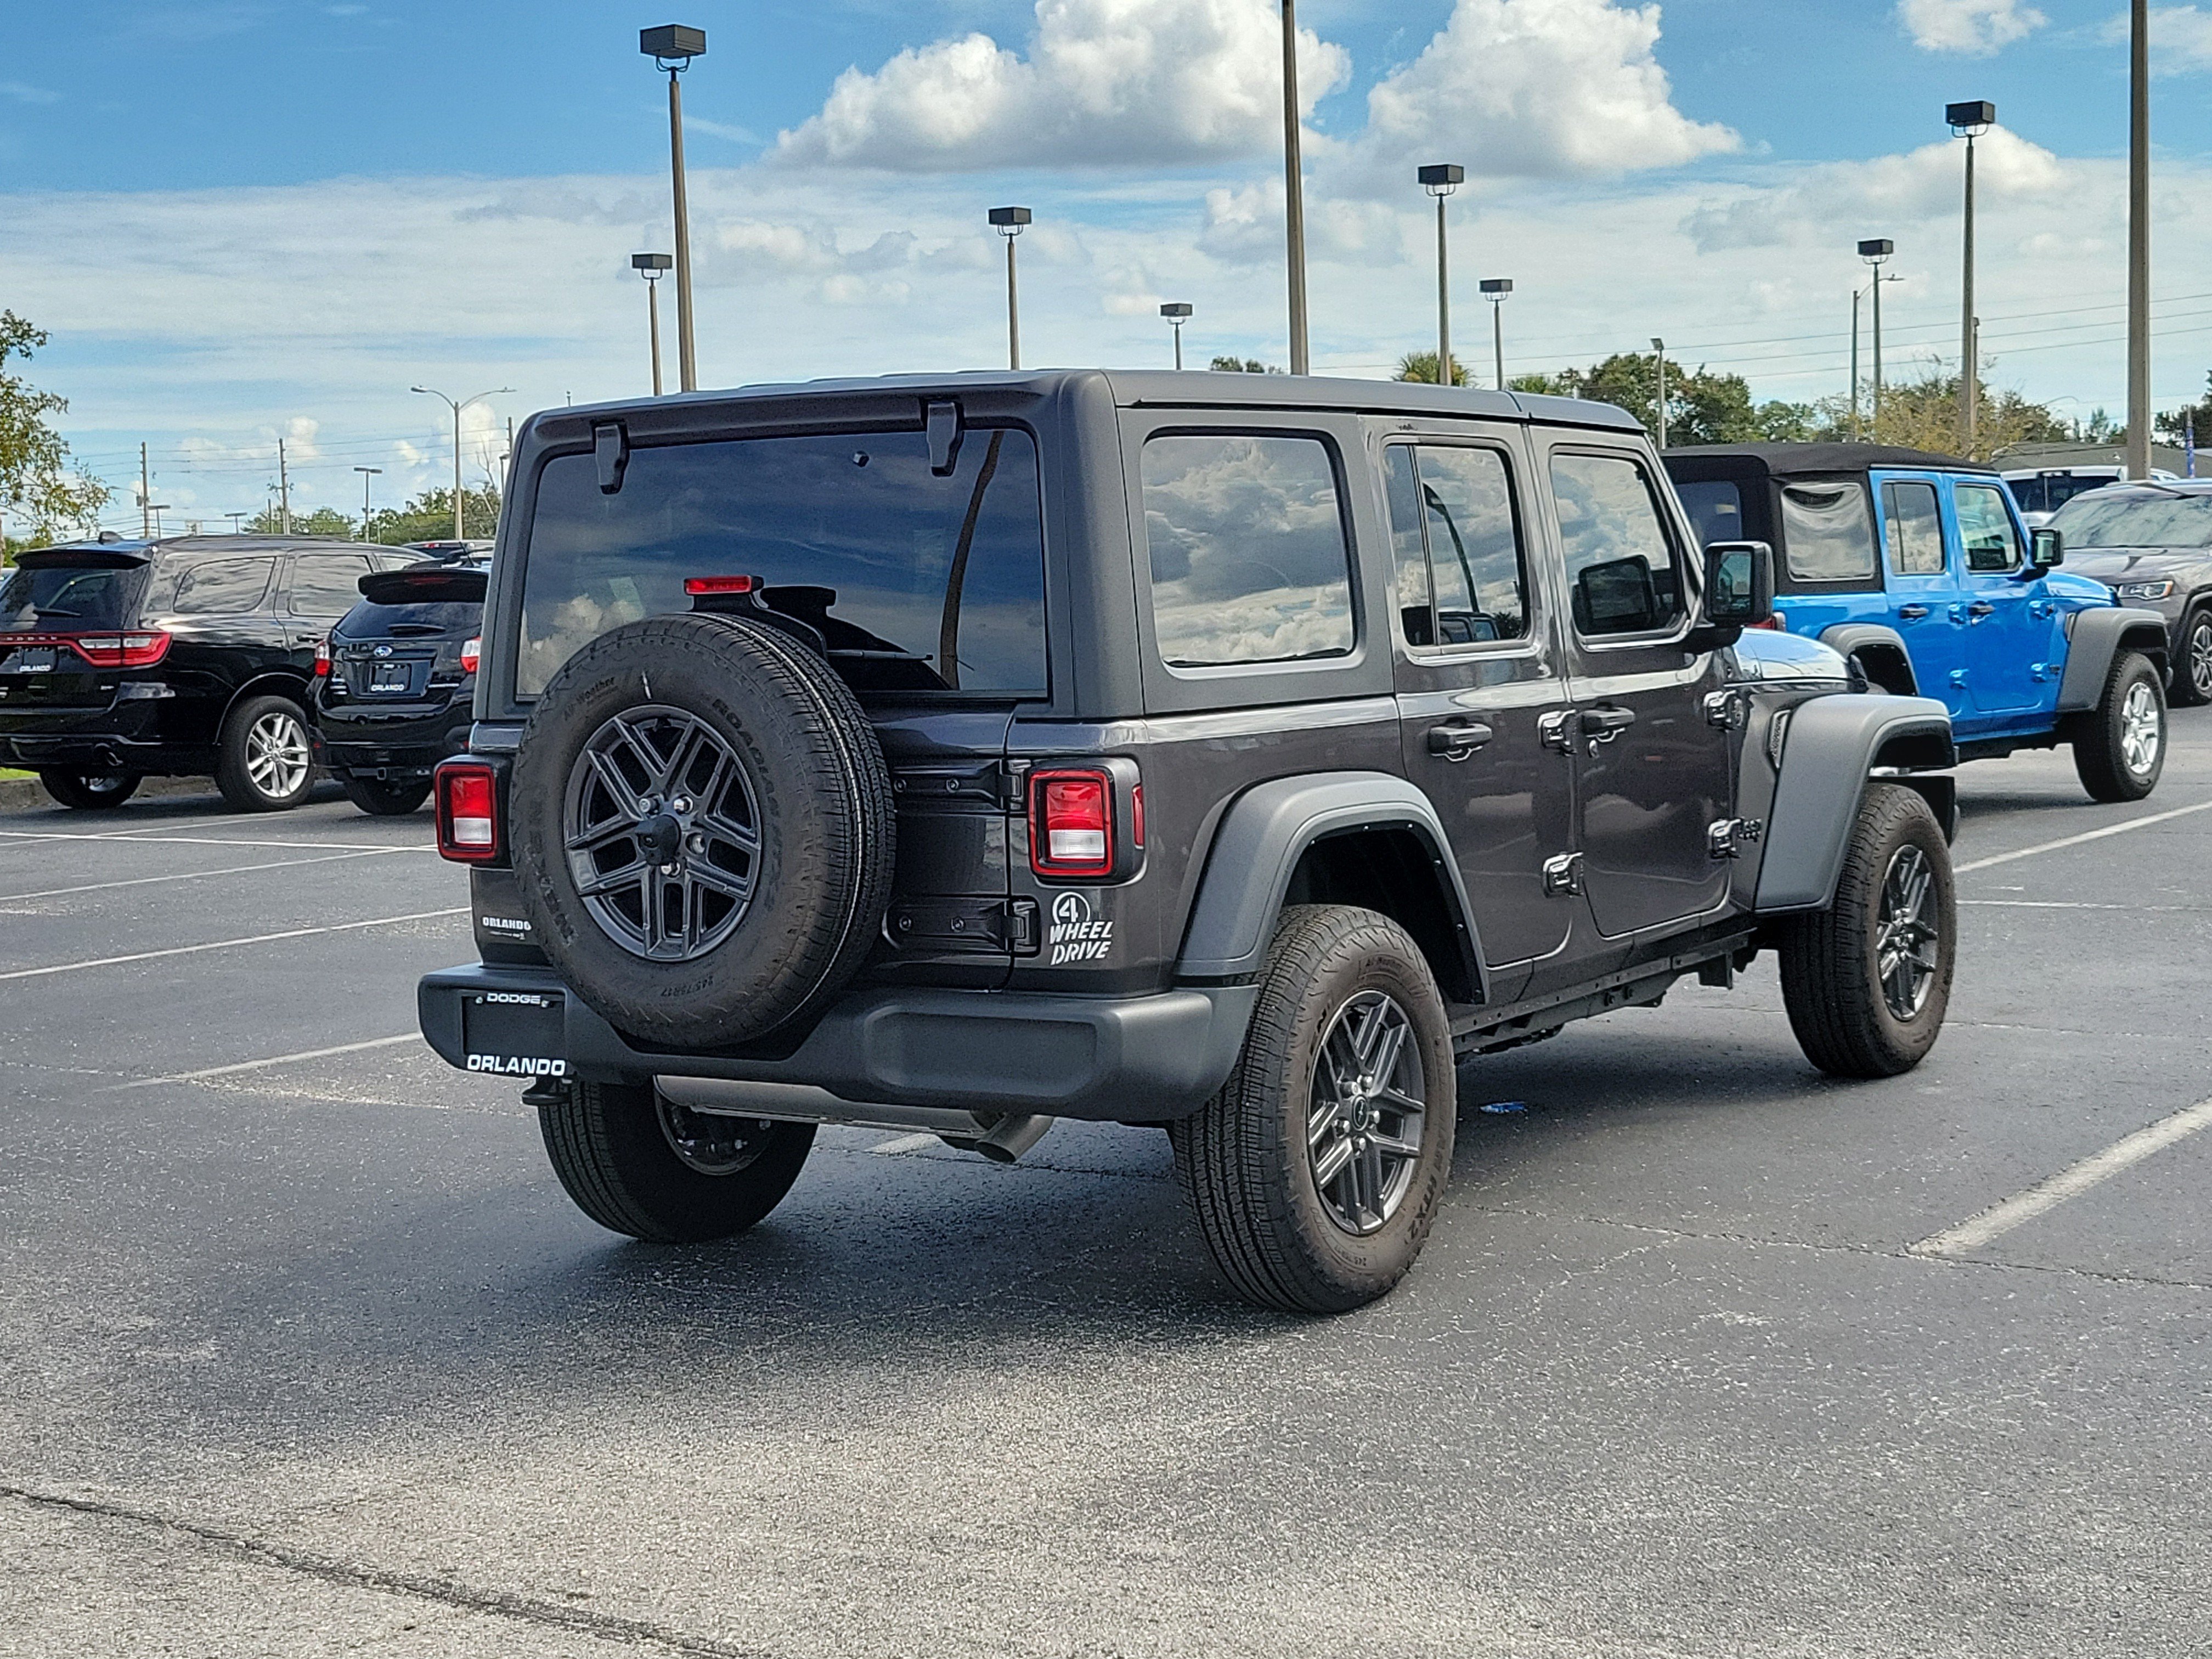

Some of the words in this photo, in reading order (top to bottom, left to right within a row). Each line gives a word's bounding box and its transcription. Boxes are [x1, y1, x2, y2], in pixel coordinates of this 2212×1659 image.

[1059, 898, 1079, 922] 4
[483, 917, 532, 931] ORLANDO
[1049, 921, 1113, 945] WHEEL
[1050, 941, 1111, 966] DRIVE
[487, 992, 541, 1005] DODGE
[467, 1054, 566, 1076] ORLANDO
